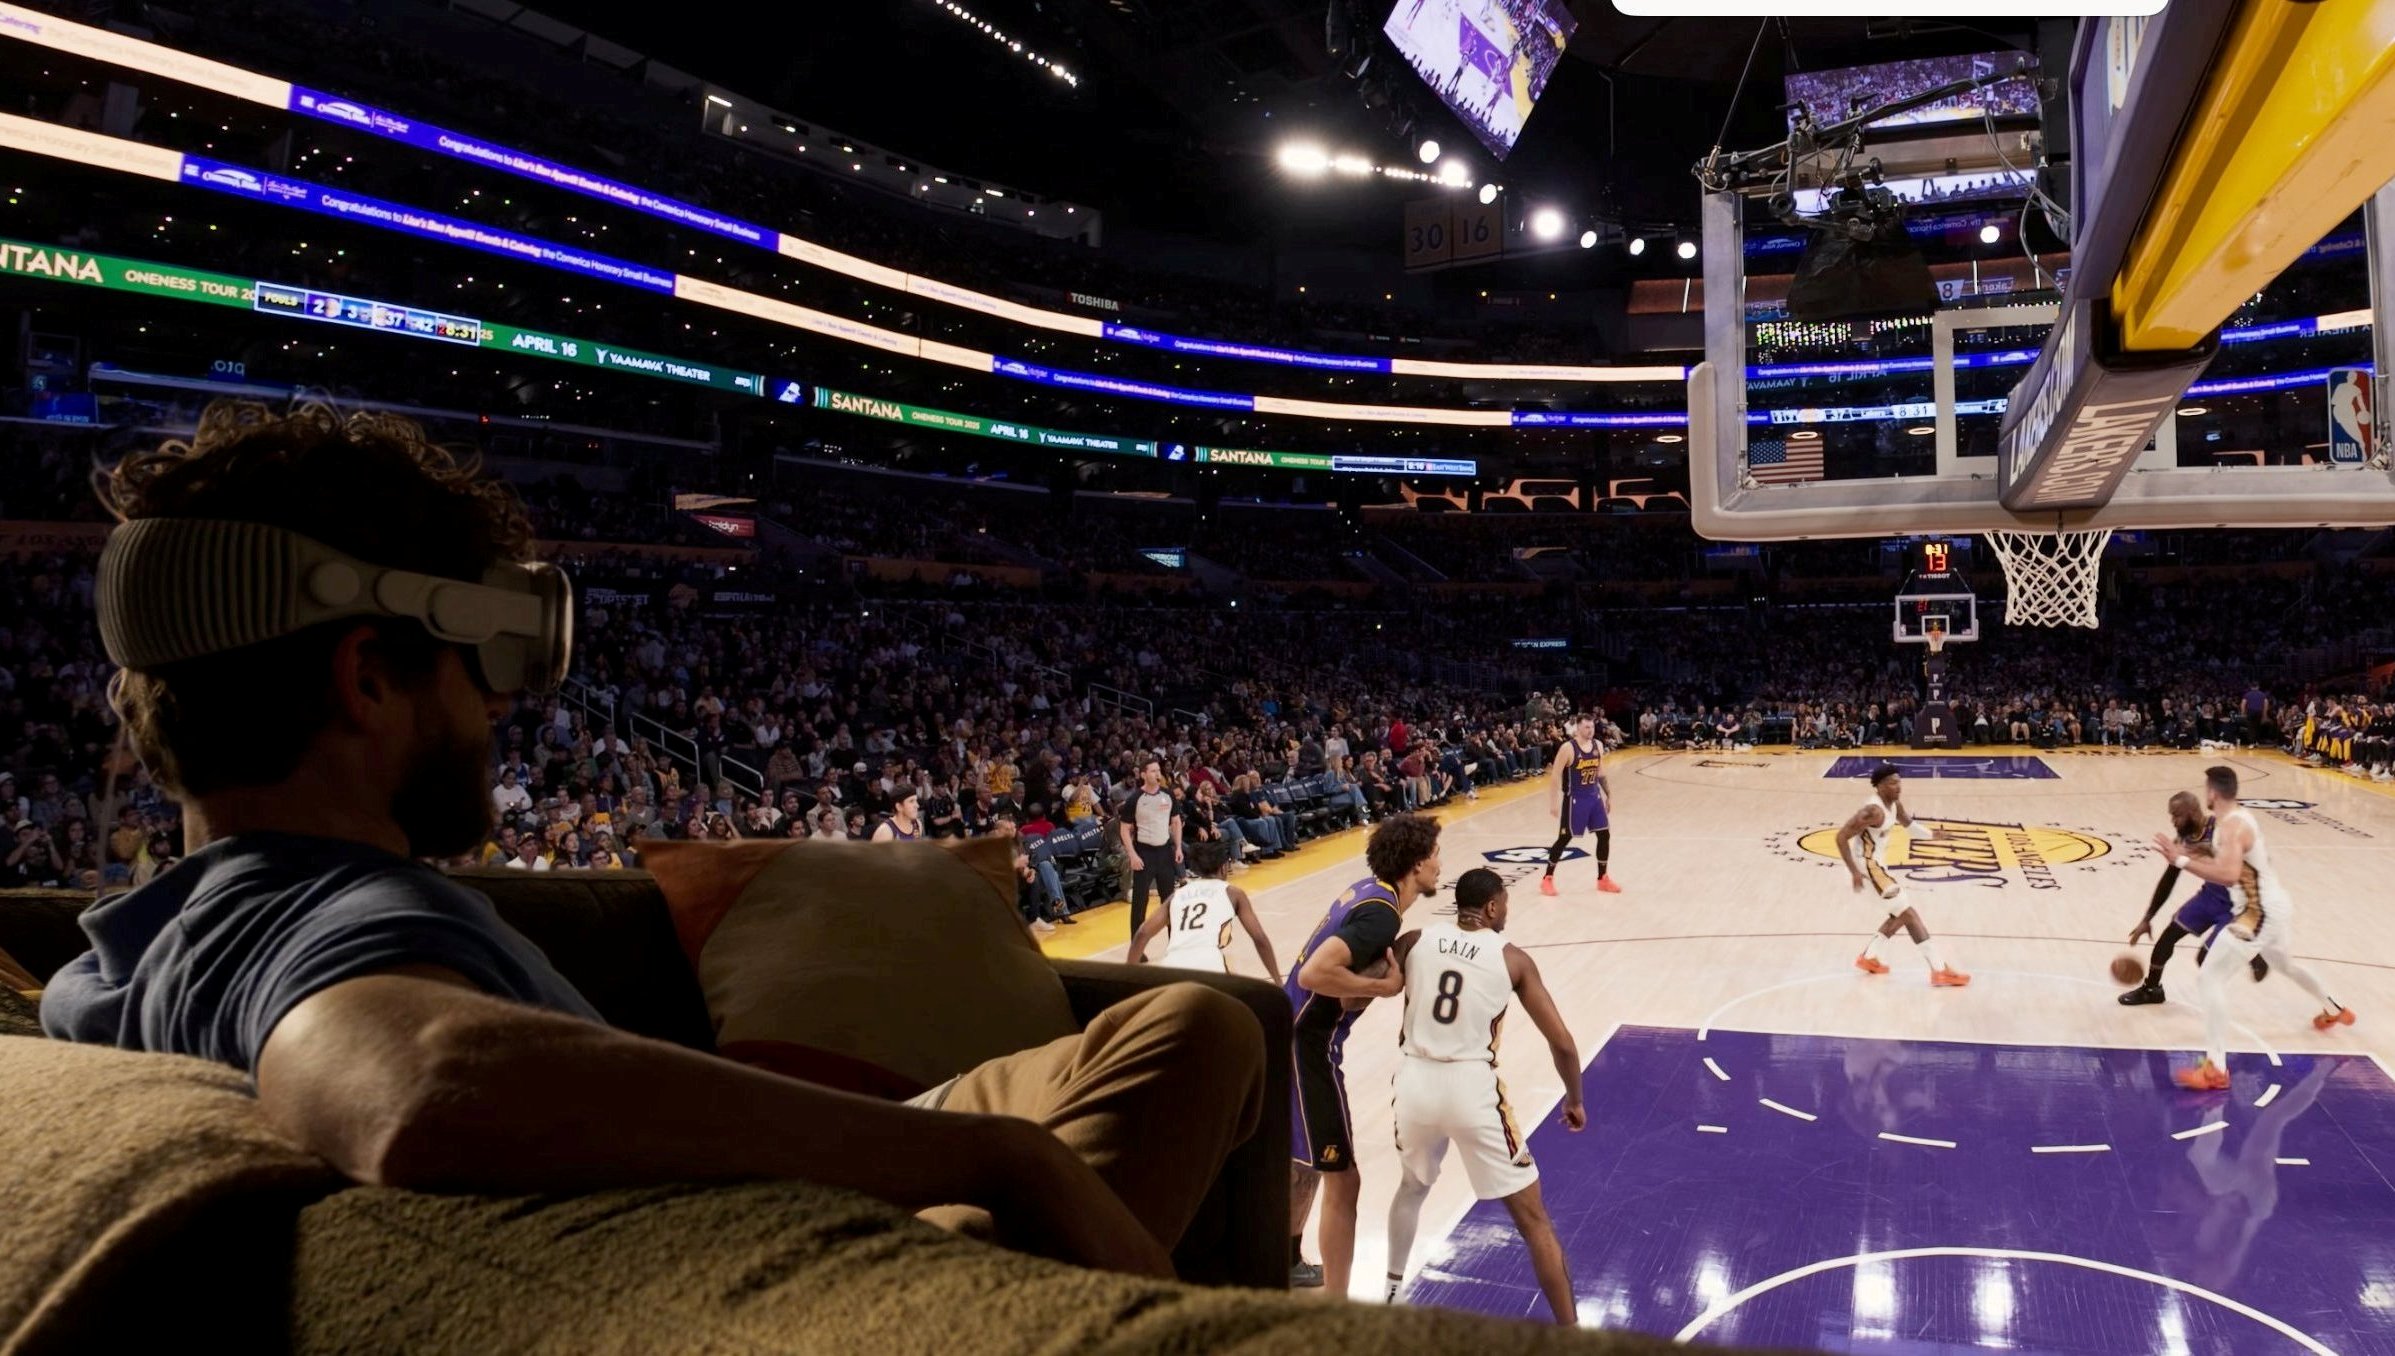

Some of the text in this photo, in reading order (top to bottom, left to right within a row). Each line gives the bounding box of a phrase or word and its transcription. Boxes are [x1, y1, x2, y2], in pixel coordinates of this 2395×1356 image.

[438, 136, 503, 163] Congratulations
[321, 194, 392, 222] Congratulations
[392, 212, 402, 223] to
[1411, 223, 1444, 253] 30
[1462, 215, 1489, 245] 16
[125, 270, 196, 291] ONENESS
[200, 280, 237, 298] TOUR
[264, 291, 299, 307] FOULS
[312, 300, 325, 314] 2
[347, 307, 358, 318] 3
[386, 313, 404, 328] 37
[445, 323, 477, 340] 8:31
[1070, 292, 1120, 312] TOSHIBA
[512, 332, 578, 358] APRIL 16
[665, 362, 711, 382] THEATER
[830, 392, 904, 421] SANTANA
[911, 411, 944, 425] ONENESS
[944, 416, 963, 428] TOUR
[990, 423, 1029, 440] APRIL 16
[1085, 438, 1119, 450] THEATER
[1210, 448, 1325, 467] SANTANA ONENESS TOUR
[2033, 395, 2174, 503] LAKERS.COM
[2335, 442, 2358, 459] NBA
[1929, 554, 1947, 571] 13
[1179, 902, 1208, 931] 12
[1438, 936, 1481, 962] CAIN
[1432, 969, 1464, 1026] 8
